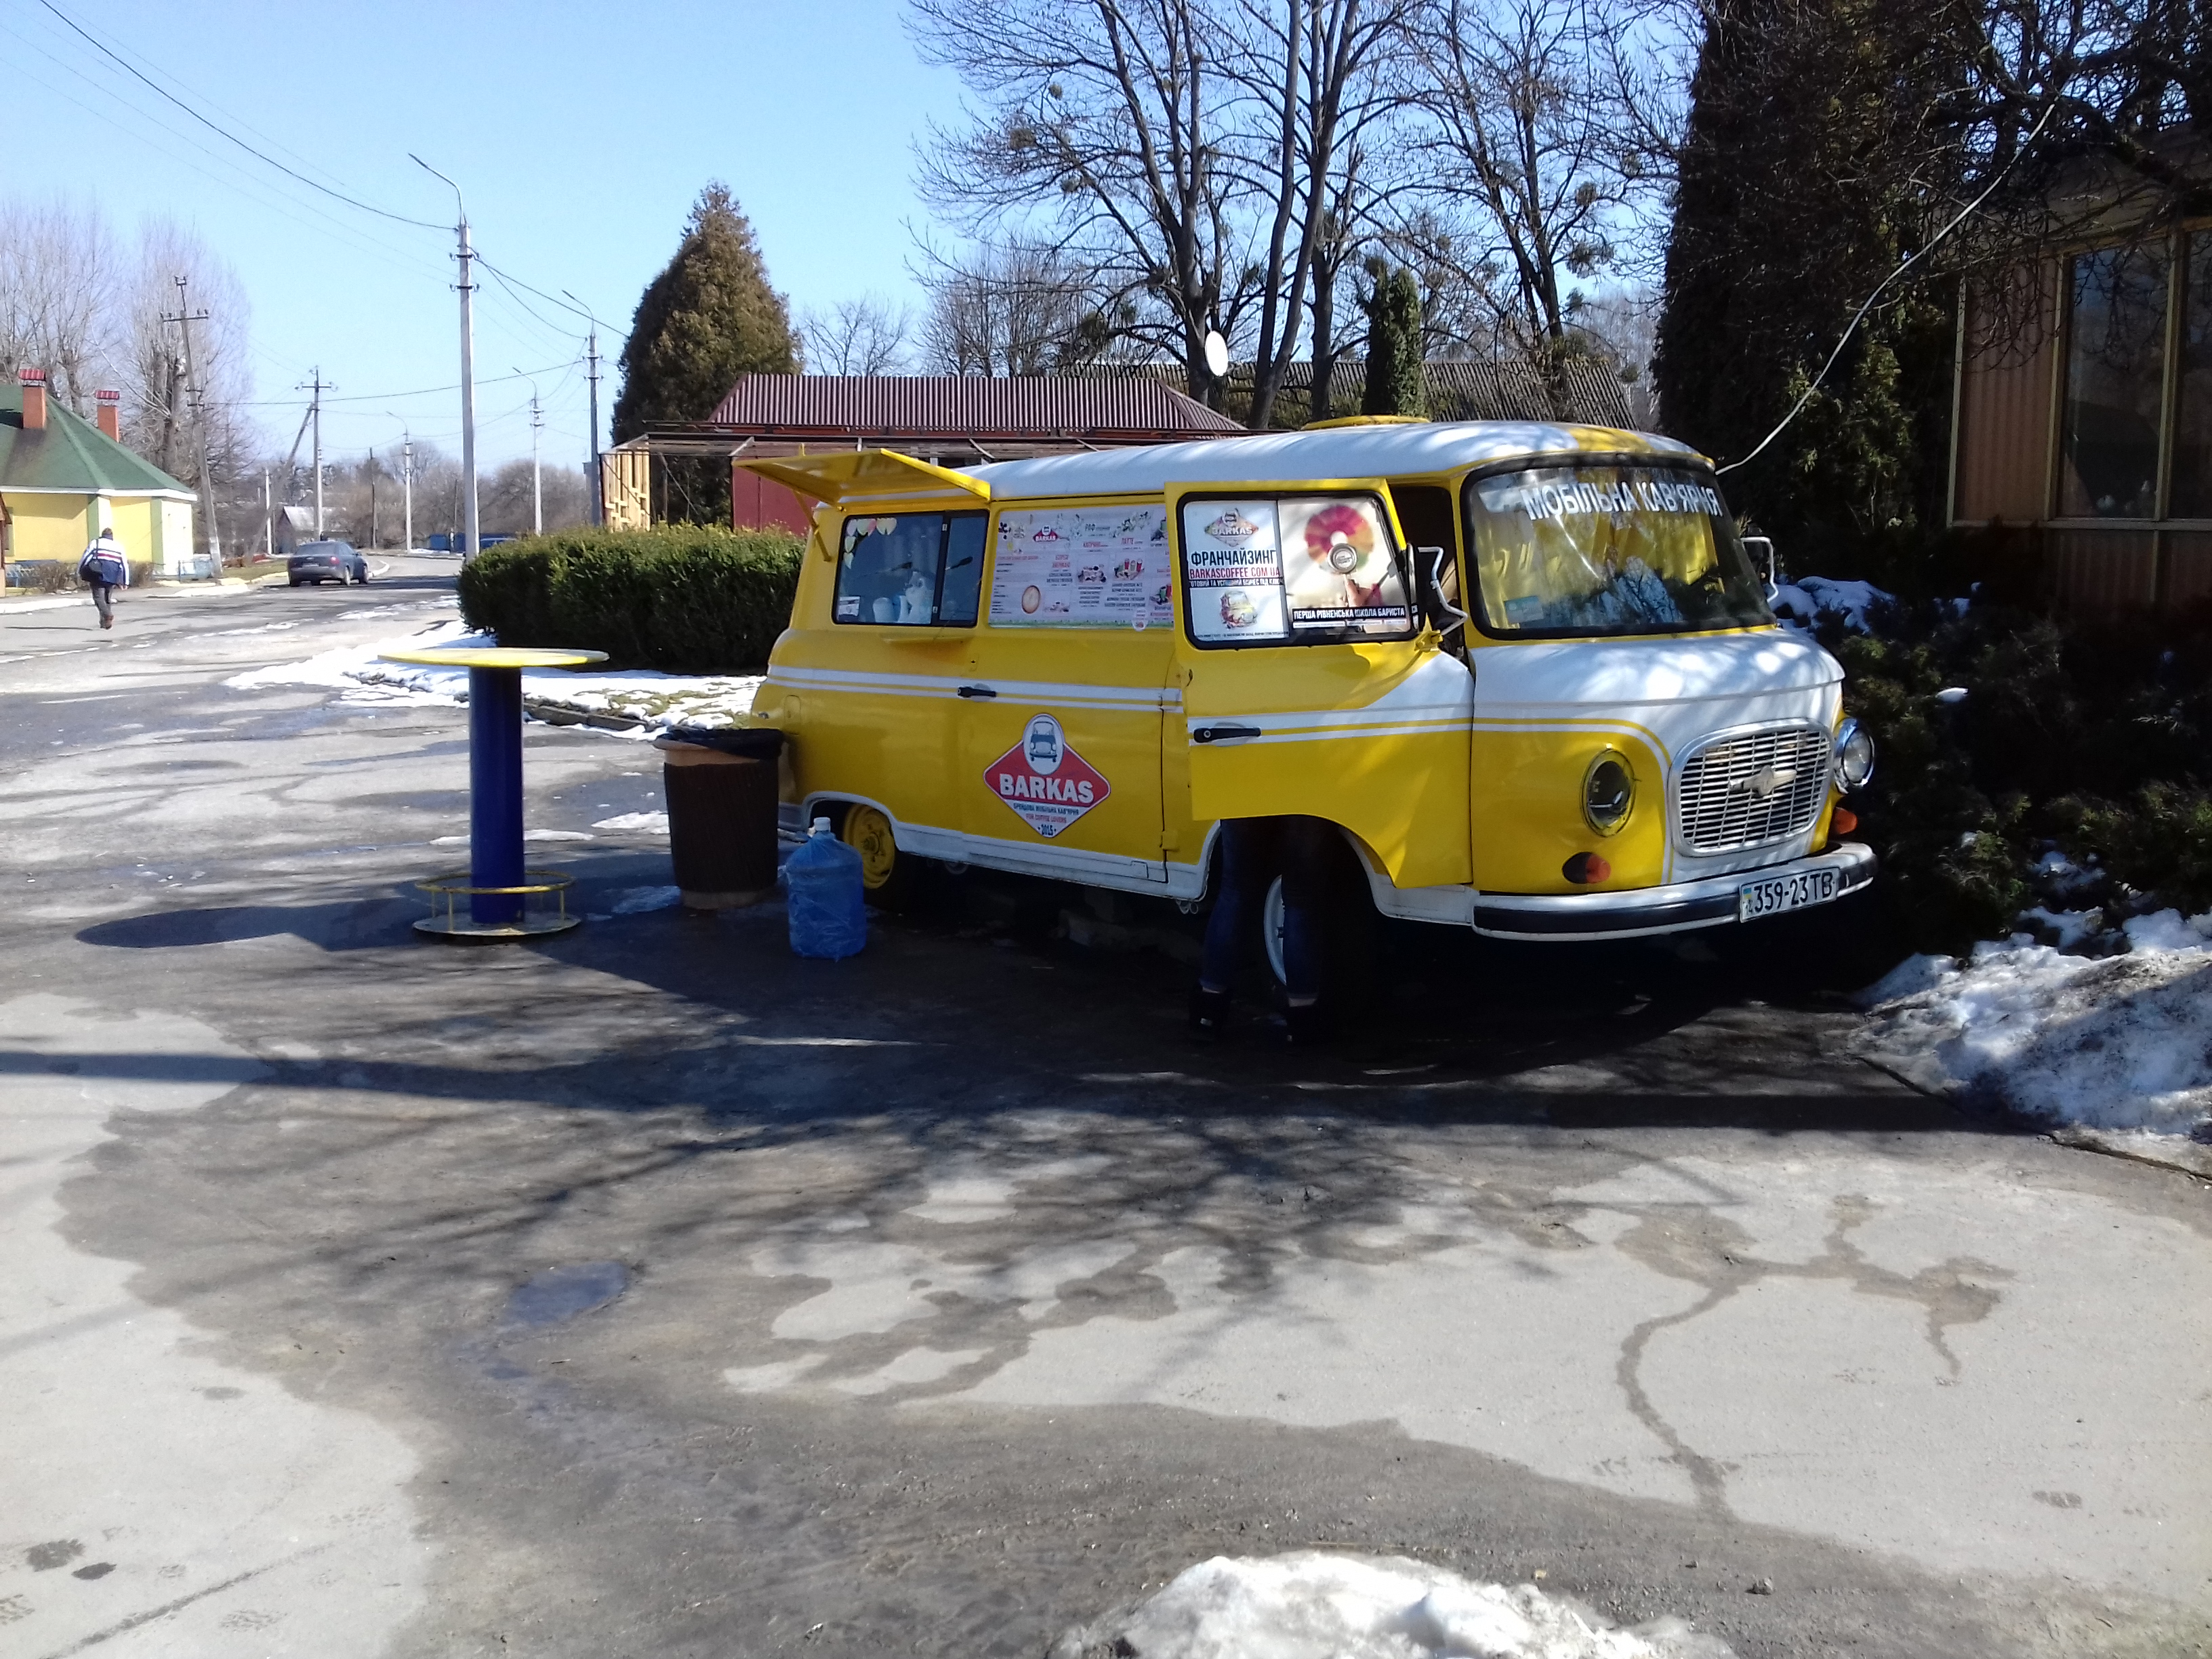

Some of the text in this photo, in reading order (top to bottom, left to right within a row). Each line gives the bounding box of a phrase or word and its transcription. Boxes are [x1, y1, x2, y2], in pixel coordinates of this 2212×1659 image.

[1520, 481, 1724, 520] МОБІЛЬНА КАВ'ЯРНЯ
[1212, 527, 1253, 535] BARKAS
[1191, 547, 1276, 567] ФРАНЧАЙЗИНГ
[1294, 611, 1316, 619] ПЕРША
[1317, 609, 1354, 619] РІВНЕНСЬКА
[1355, 608, 1377, 617] ШКОЛА
[1378, 607, 1405, 616] БАРИСТА
[1000, 773, 1094, 804] BARKAS
